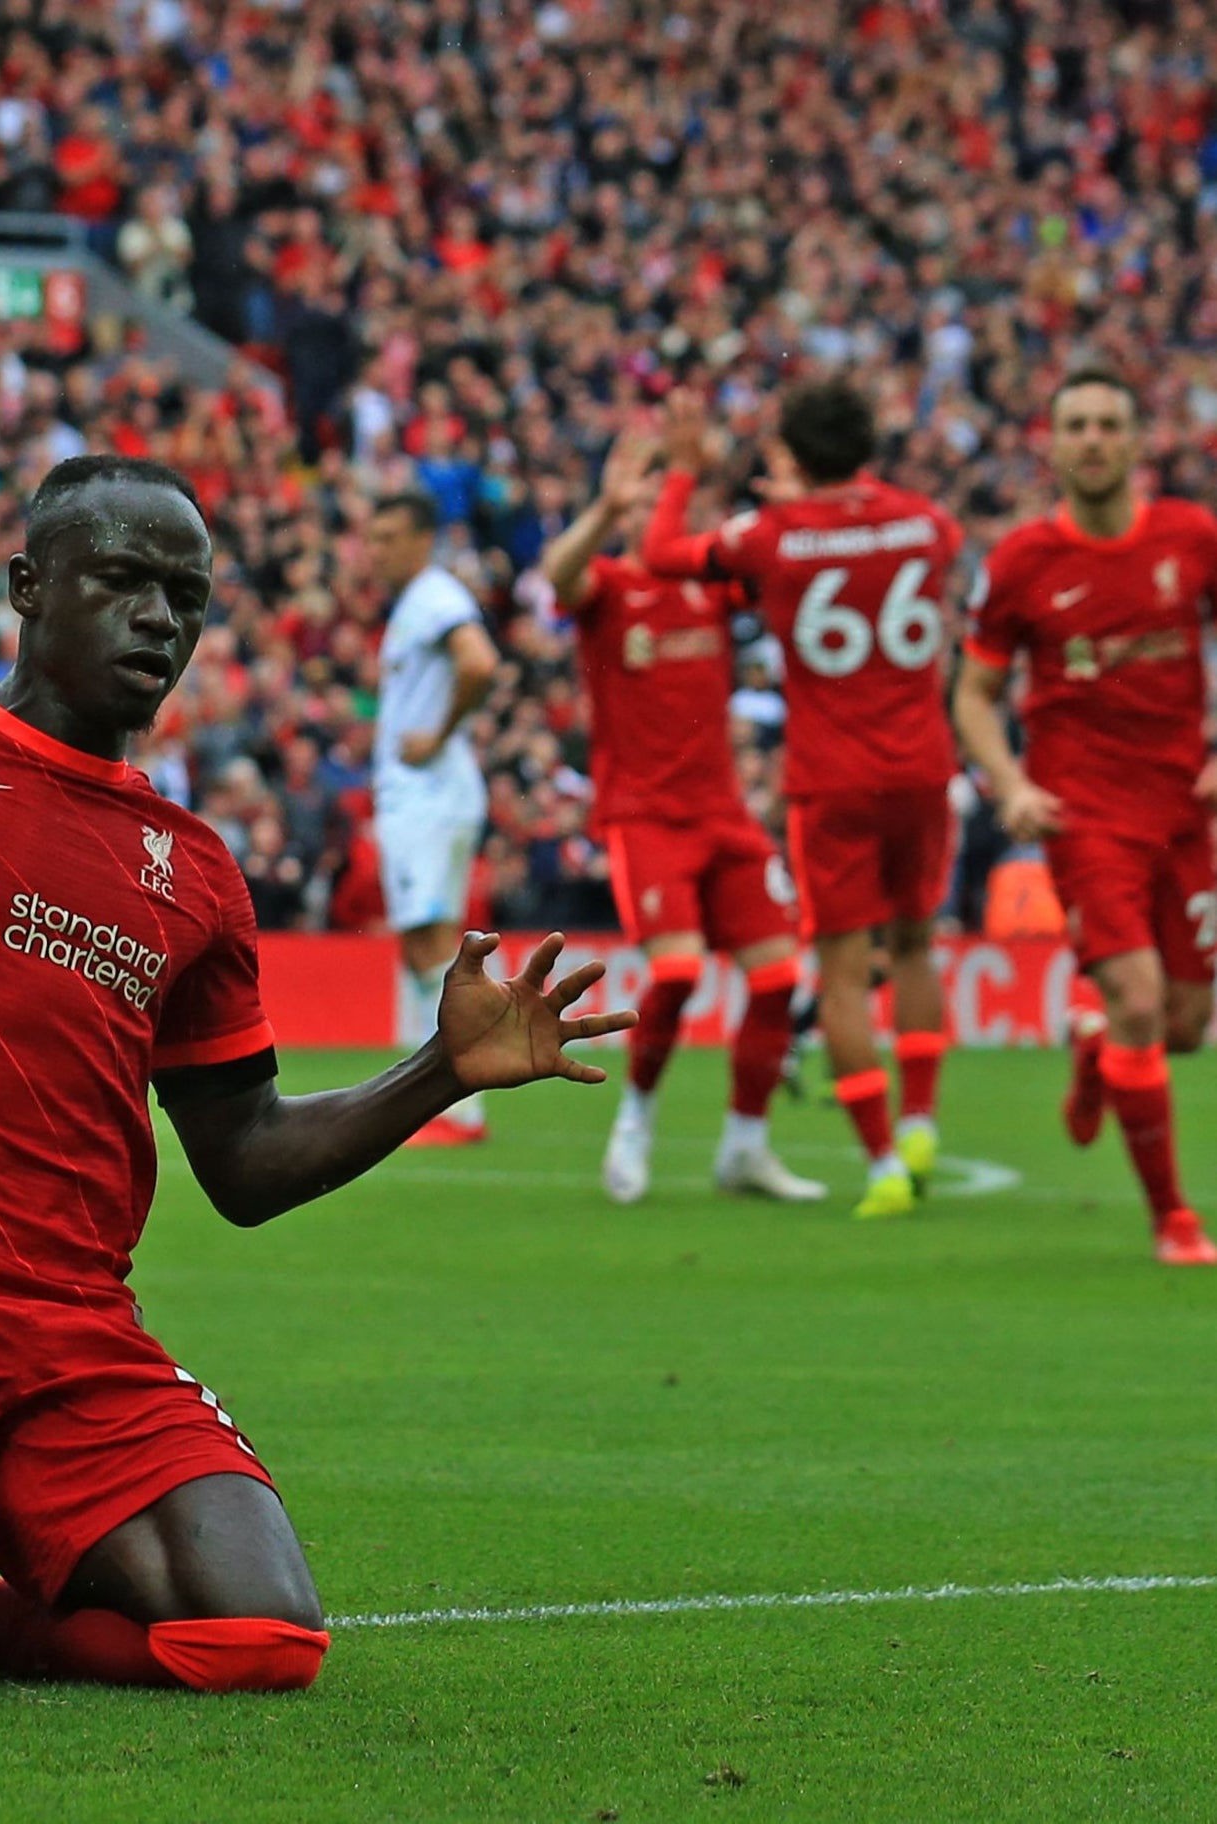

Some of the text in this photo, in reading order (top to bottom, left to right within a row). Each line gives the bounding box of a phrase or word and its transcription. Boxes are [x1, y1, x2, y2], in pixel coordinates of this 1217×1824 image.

[792, 558, 944, 678] 66
[3, 923, 158, 1012] chartered
[9, 892, 168, 980] standard
